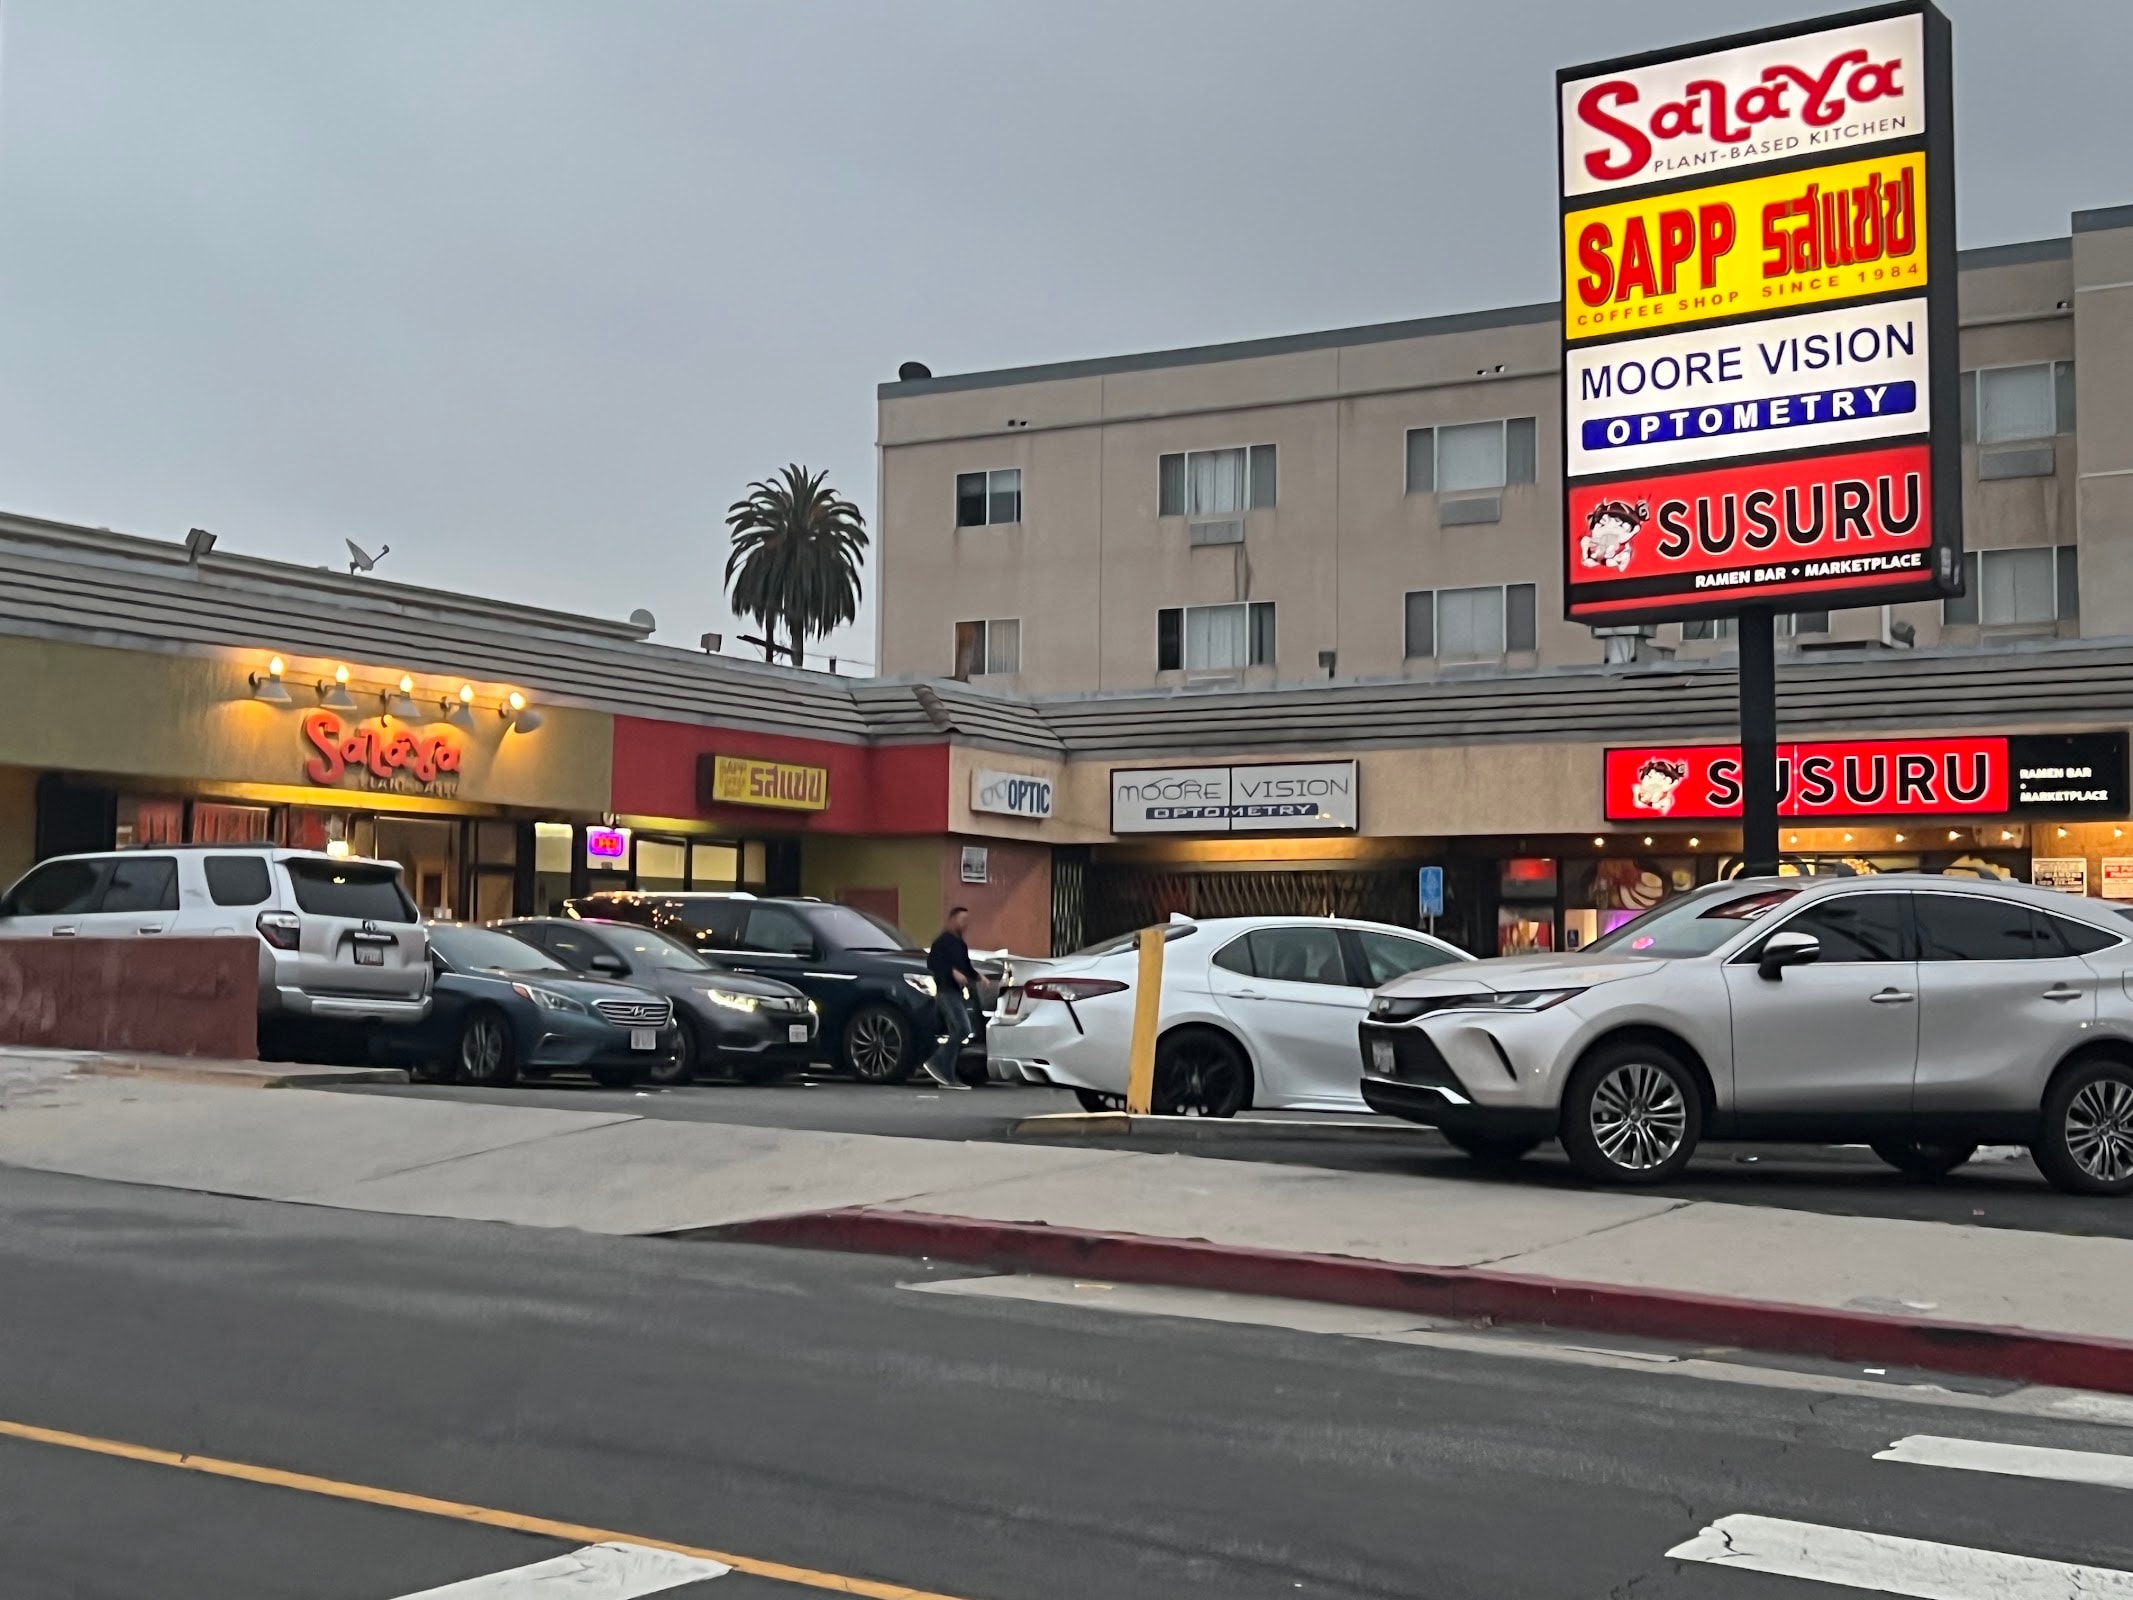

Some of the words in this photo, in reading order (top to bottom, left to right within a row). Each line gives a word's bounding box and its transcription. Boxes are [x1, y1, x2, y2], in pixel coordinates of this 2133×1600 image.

[1654, 136, 1800, 173] PLANT-BASED
[1810, 116, 1907, 146] KITCHEN
[1577, 202, 1737, 307] SAPP
[1577, 303, 1664, 326] COFFEE
[1678, 291, 1739, 311] SHOP
[1762, 275, 1839, 297] SINCE
[1858, 263, 1918, 283] 1984
[1581, 347, 1742, 401] MOORE
[1758, 321, 1914, 376] VISION
[1606, 386, 1888, 445] OPTOMETRY
[1655, 472, 1922, 561] SUSURU
[1695, 571, 1750, 588] RAMEN
[1754, 567, 1786, 583] BAR
[1804, 553, 1922, 577] MARKETPLACE
[1118, 779, 1222, 802] MOORE
[1240, 777, 1348, 799] VISION
[2019, 768, 2064, 779] RAMEN
[2065, 767, 2092, 778] BAR
[2019, 790, 2108, 802] MARKETPLACE
[1008, 779, 1050, 814] OPTIC
[1154, 804, 1311, 819] OPTOMETRY
